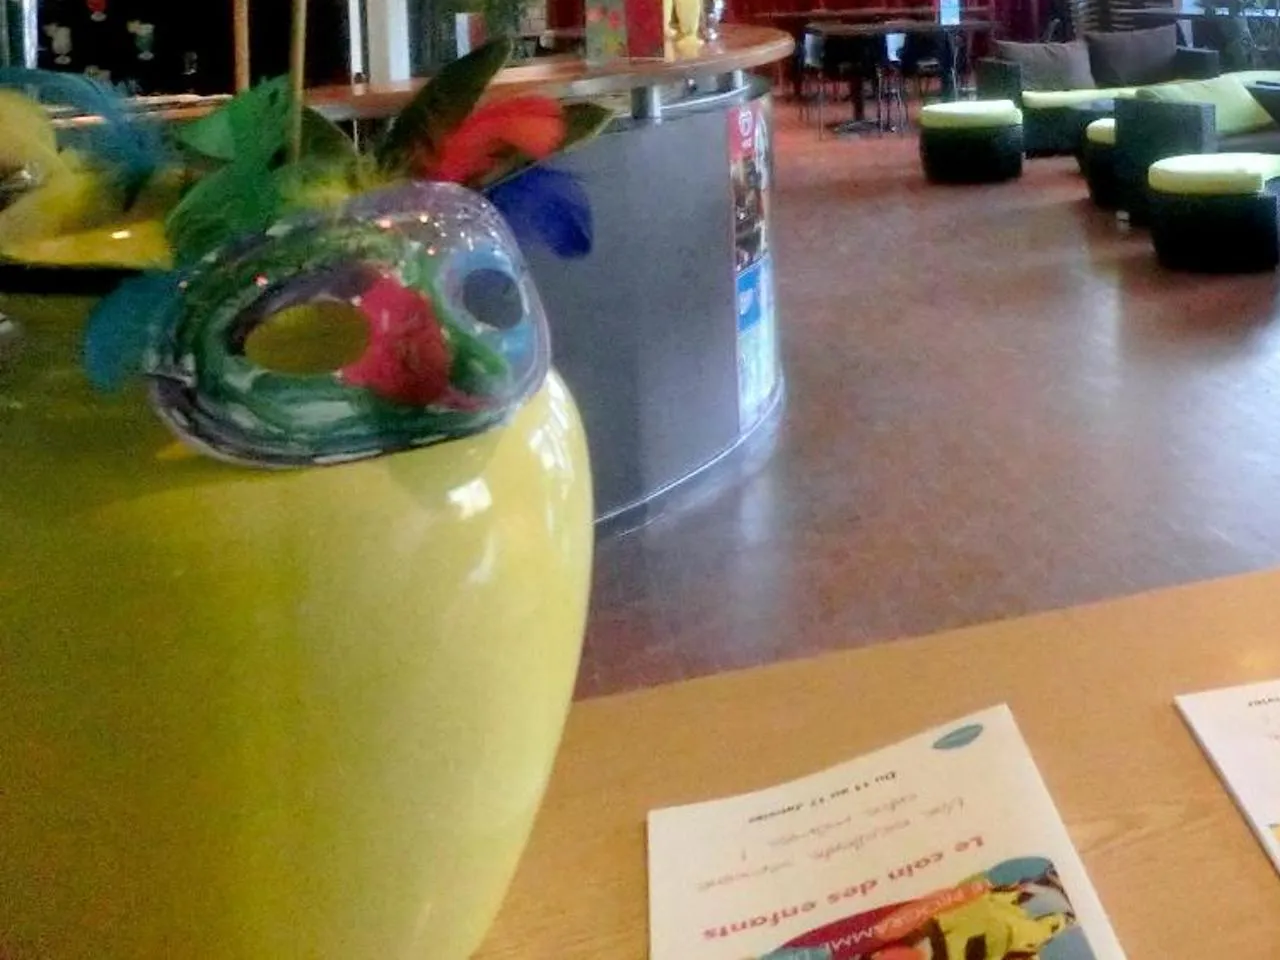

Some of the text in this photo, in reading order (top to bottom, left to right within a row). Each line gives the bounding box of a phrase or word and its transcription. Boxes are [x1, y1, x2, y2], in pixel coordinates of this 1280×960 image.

[702, 835, 984, 940] Le coin des enfants
